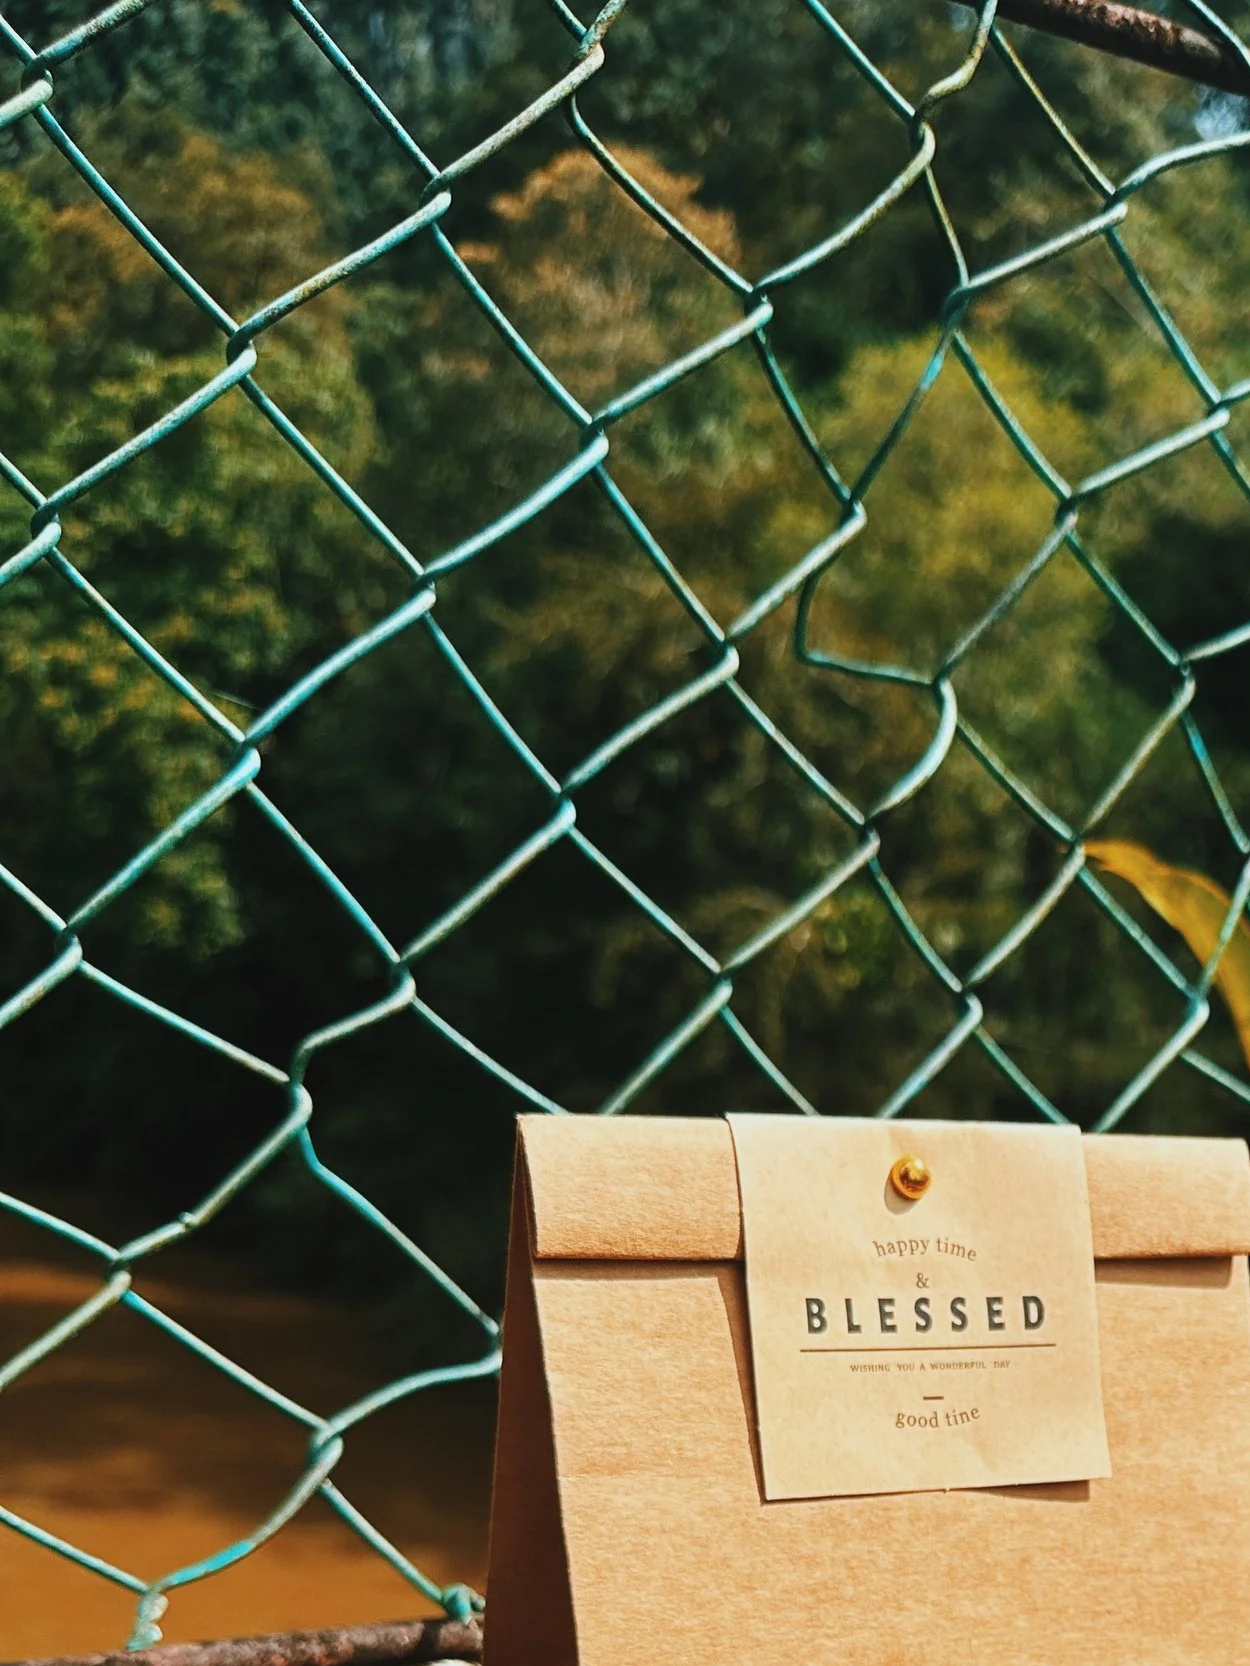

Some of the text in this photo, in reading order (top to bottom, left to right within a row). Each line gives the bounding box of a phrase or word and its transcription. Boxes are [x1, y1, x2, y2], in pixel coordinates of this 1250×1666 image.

[873, 1237, 977, 1262] happy time
[916, 1273, 930, 1289] &
[805, 1295, 1046, 1335] BLESSED
[850, 1364, 890, 1373] WISHING
[897, 1362, 915, 1372] YOU
[919, 1362, 926, 1371] A
[993, 1360, 1011, 1369] DAY
[895, 1406, 981, 1429] good tine
